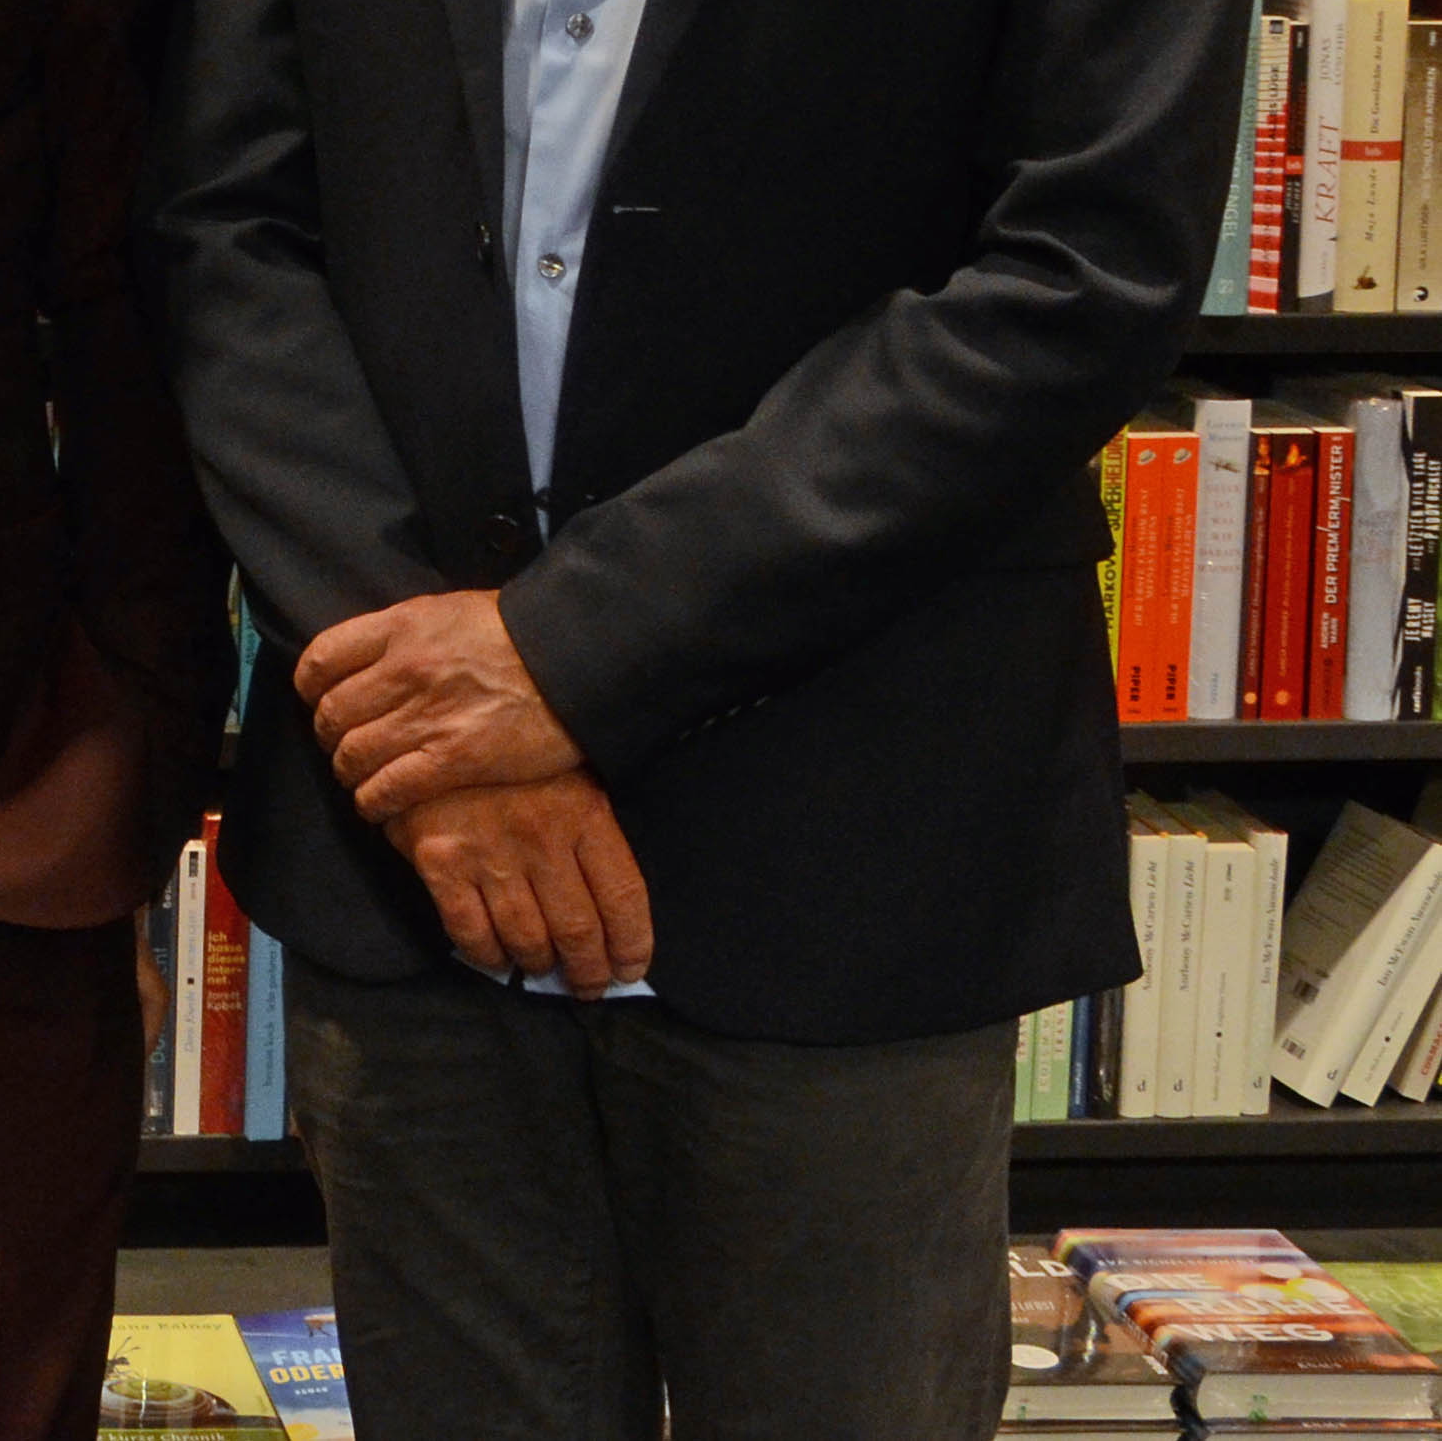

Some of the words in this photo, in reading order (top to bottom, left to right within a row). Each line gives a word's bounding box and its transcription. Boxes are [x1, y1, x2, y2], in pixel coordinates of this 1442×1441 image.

[1369, 10, 1383, 42] Bienen
[1319, 38, 1331, 80] JONAS
[1369, 45, 1383, 62] der
[1369, 64, 1383, 116] Geschichte
[1369, 118, 1383, 134] Die
[1314, 115, 1339, 225] KRAFT
[1365, 168, 1376, 205] Lunde
[1365, 211, 1376, 242] Maja
[1325, 576, 1338, 604] DER
[1404, 598, 1422, 641] JEREMY
[1422, 602, 1434, 638] MASSEY
[1108, 1275, 1223, 1290] DIE
[1175, 1298, 1367, 1315] RUHE
[1172, 1323, 1334, 1342] WEG
